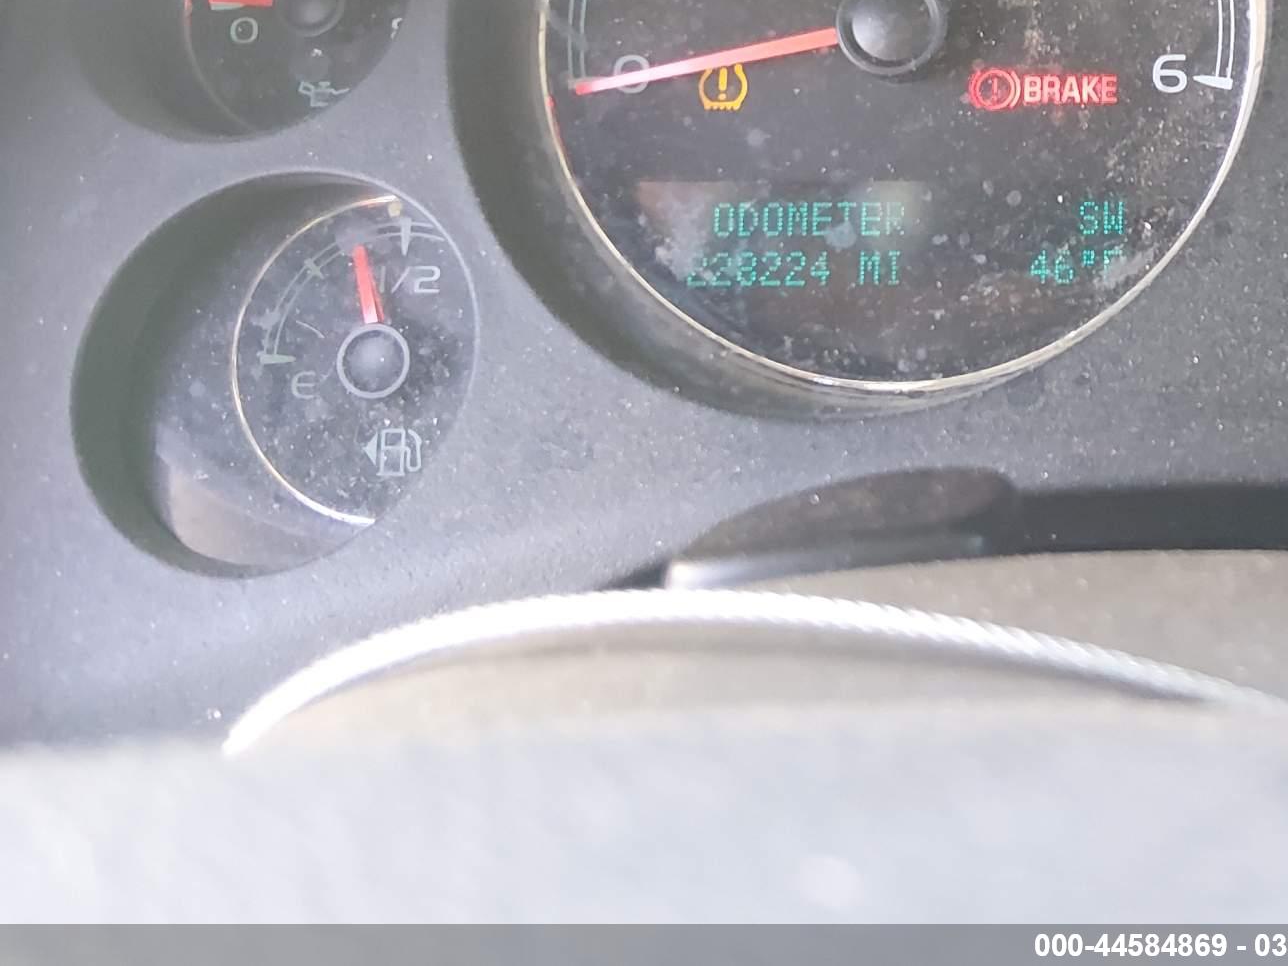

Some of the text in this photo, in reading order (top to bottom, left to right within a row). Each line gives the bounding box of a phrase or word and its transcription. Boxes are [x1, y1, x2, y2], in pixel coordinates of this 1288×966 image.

[230, 17, 259, 44] 0
[1152, 54, 1187, 93] 6
[1024, 75, 1117, 105] BRAKE
[714, 202, 904, 236] ODOMETER
[1080, 201, 1122, 234] SW
[379, 265, 441, 294] 1/2
[859, 251, 900, 285] MI
[291, 370, 318, 399] E
